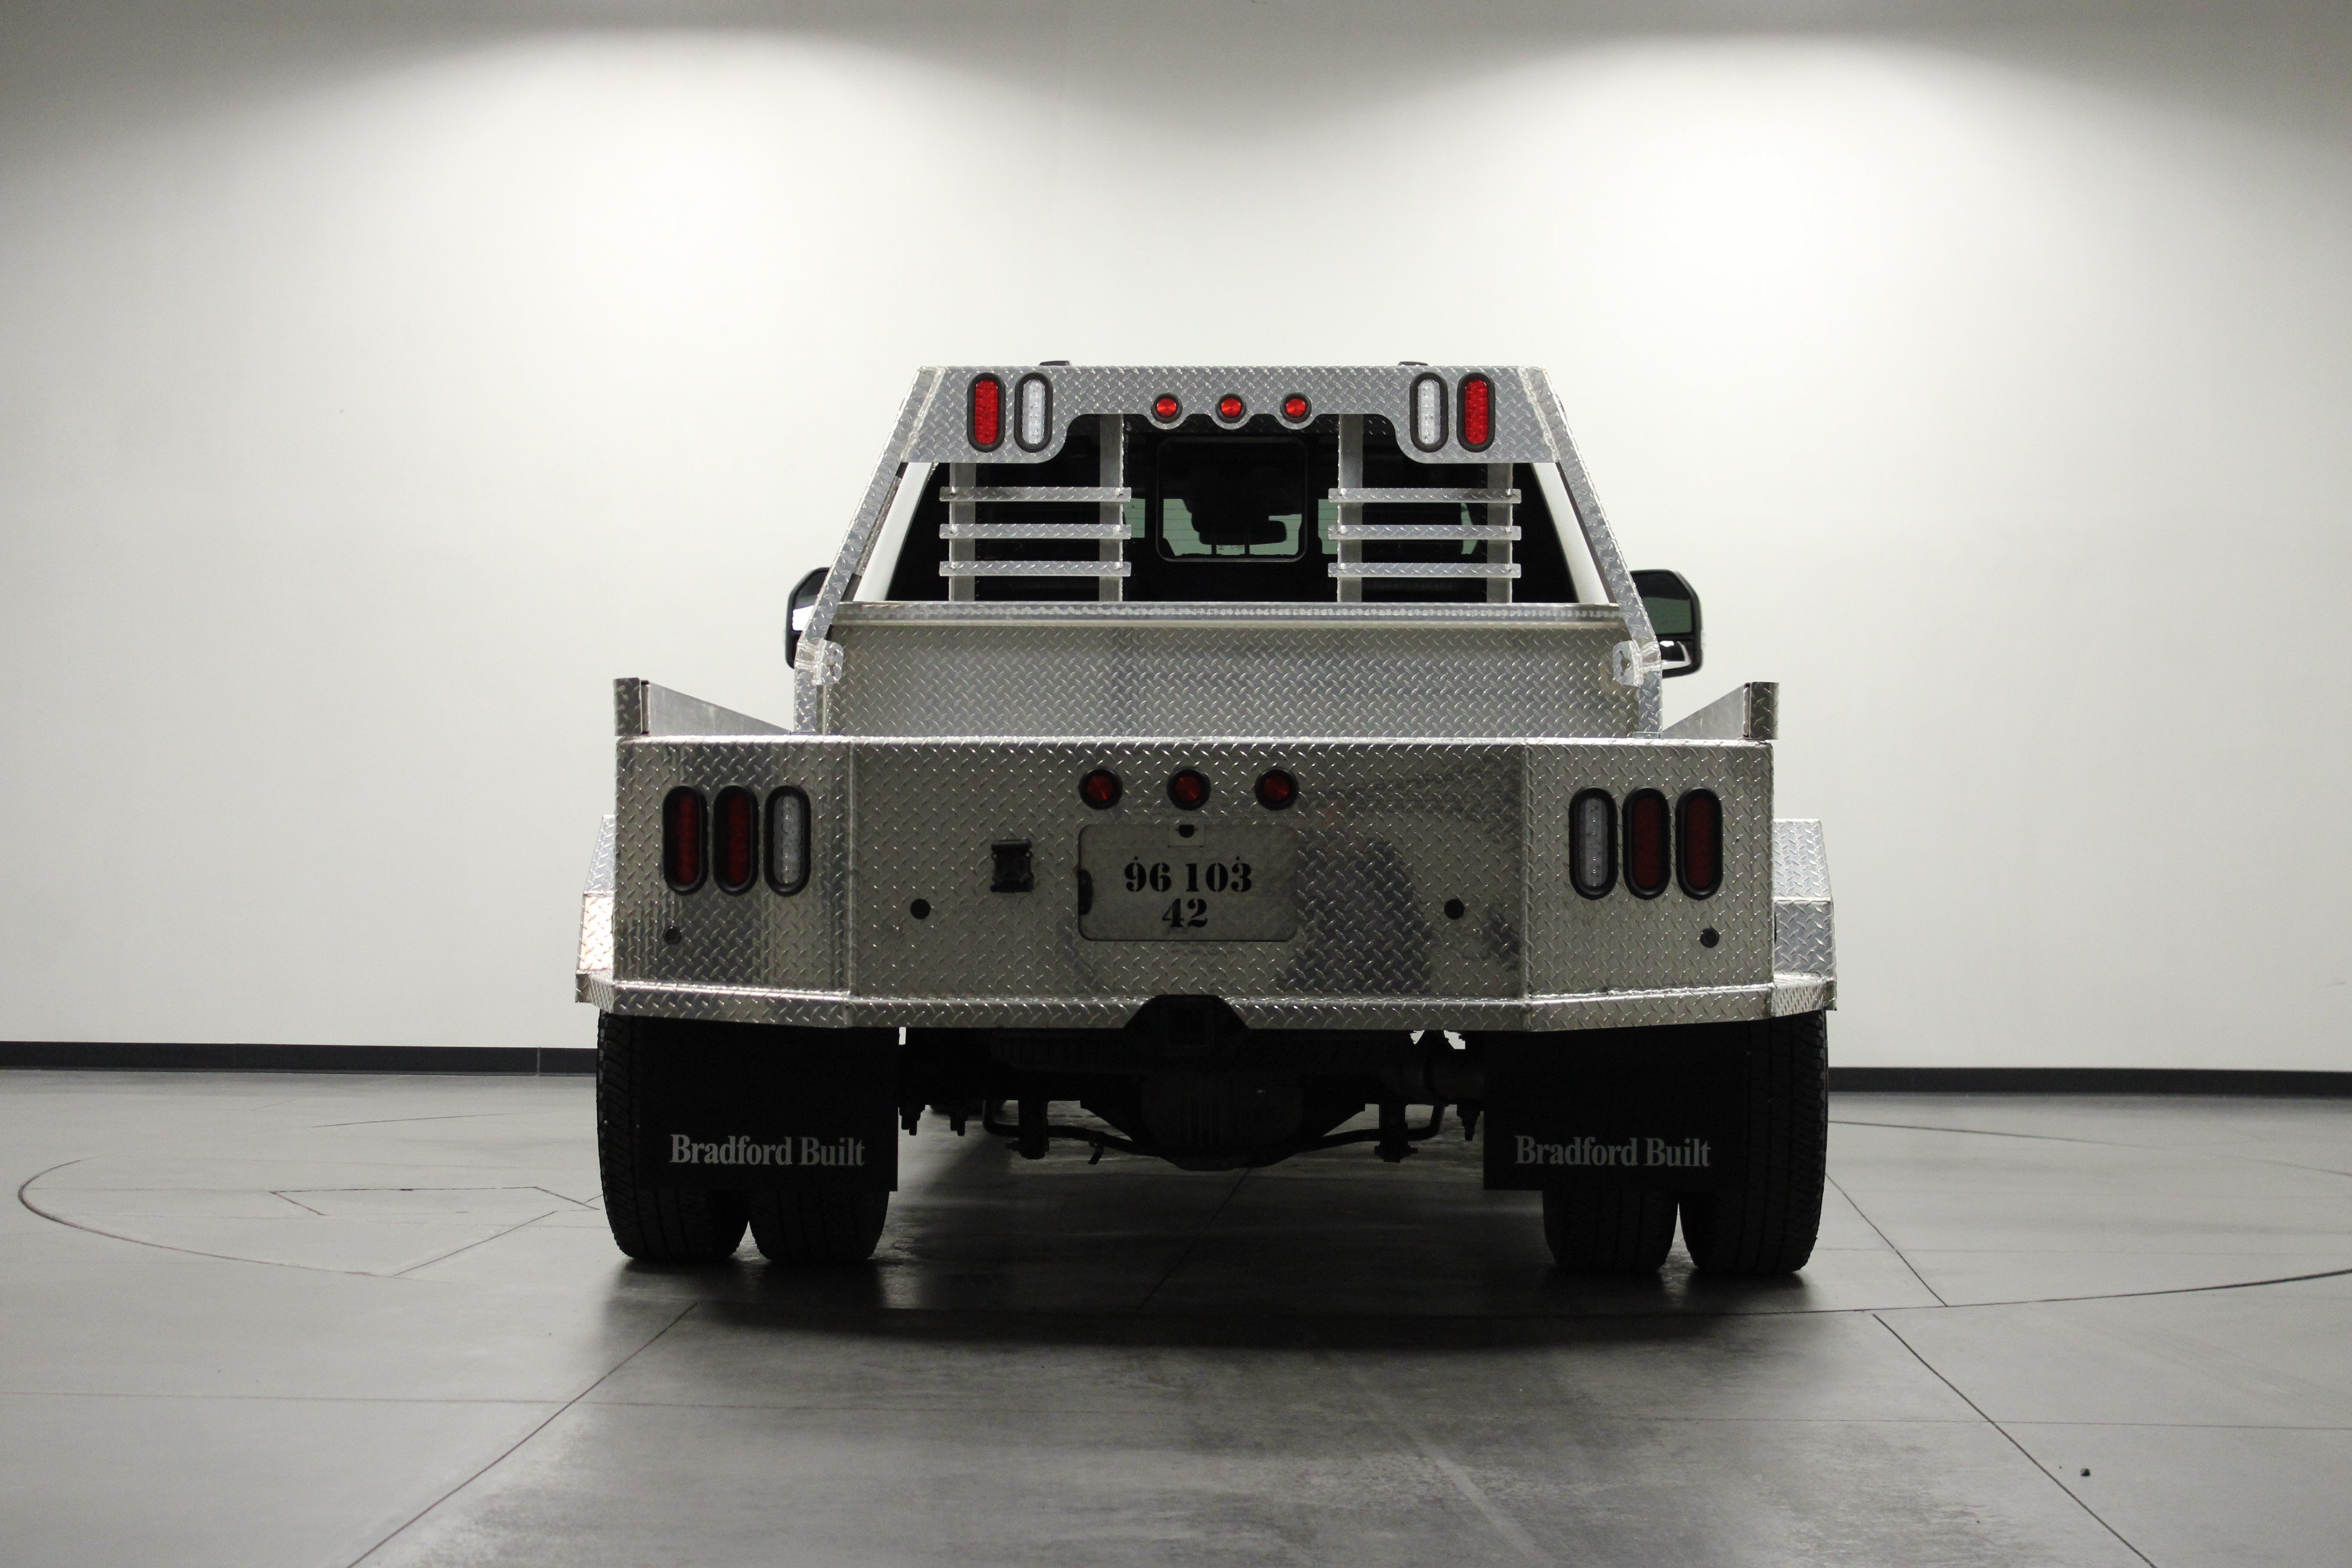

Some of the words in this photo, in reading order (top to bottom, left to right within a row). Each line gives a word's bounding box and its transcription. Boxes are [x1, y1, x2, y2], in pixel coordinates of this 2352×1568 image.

[1123, 862, 1172, 893] 96
[1185, 862, 1252, 893] 103
[1161, 898, 1208, 928] 42
[669, 1133, 792, 1165] Bradford
[799, 1136, 865, 1167] Built
[1514, 1135, 1638, 1166] Bradford
[1644, 1137, 1711, 1167] Built
